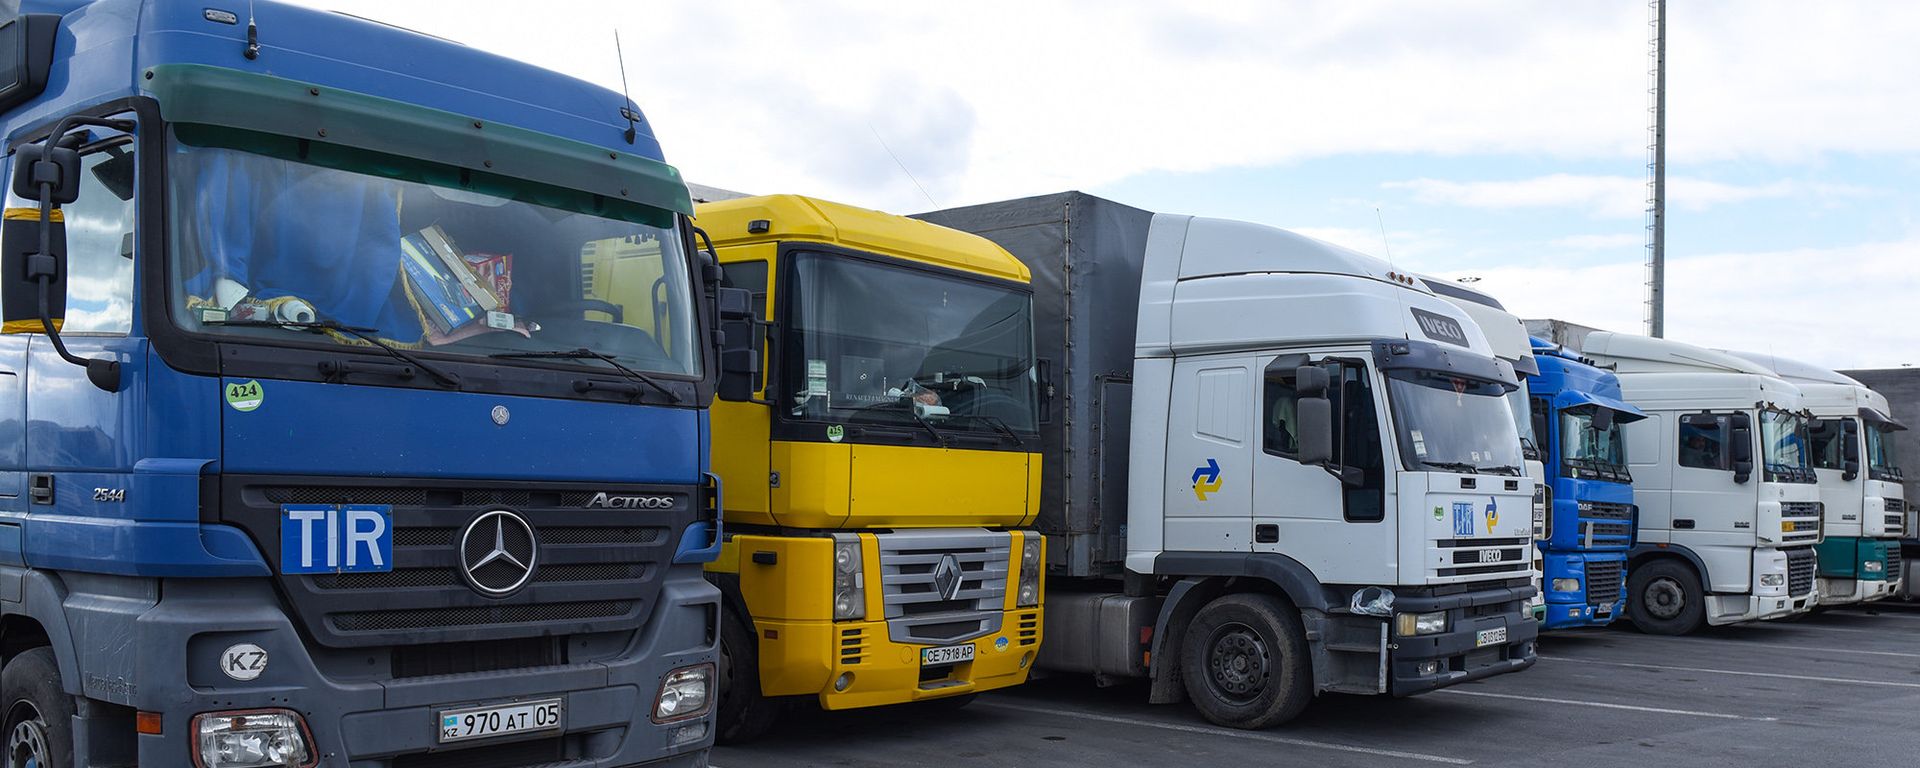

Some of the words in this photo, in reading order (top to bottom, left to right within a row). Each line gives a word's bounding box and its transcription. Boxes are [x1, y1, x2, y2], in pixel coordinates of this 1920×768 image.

[1418, 314, 1462, 340] IVECO
[231, 384, 258, 398] 424
[93, 487, 125, 502] 2544
[1454, 504, 1474, 534] TIR
[289, 510, 385, 567] TIR
[1479, 549, 1502, 563] IVECO
[229, 651, 265, 671] KZ
[927, 650, 940, 662] CE
[941, 648, 960, 660] 7918
[961, 646, 973, 658] AP
[464, 711, 500, 735] 970
[505, 712, 528, 730] AT
[536, 705, 559, 726] 05
[443, 728, 458, 738] KZ
